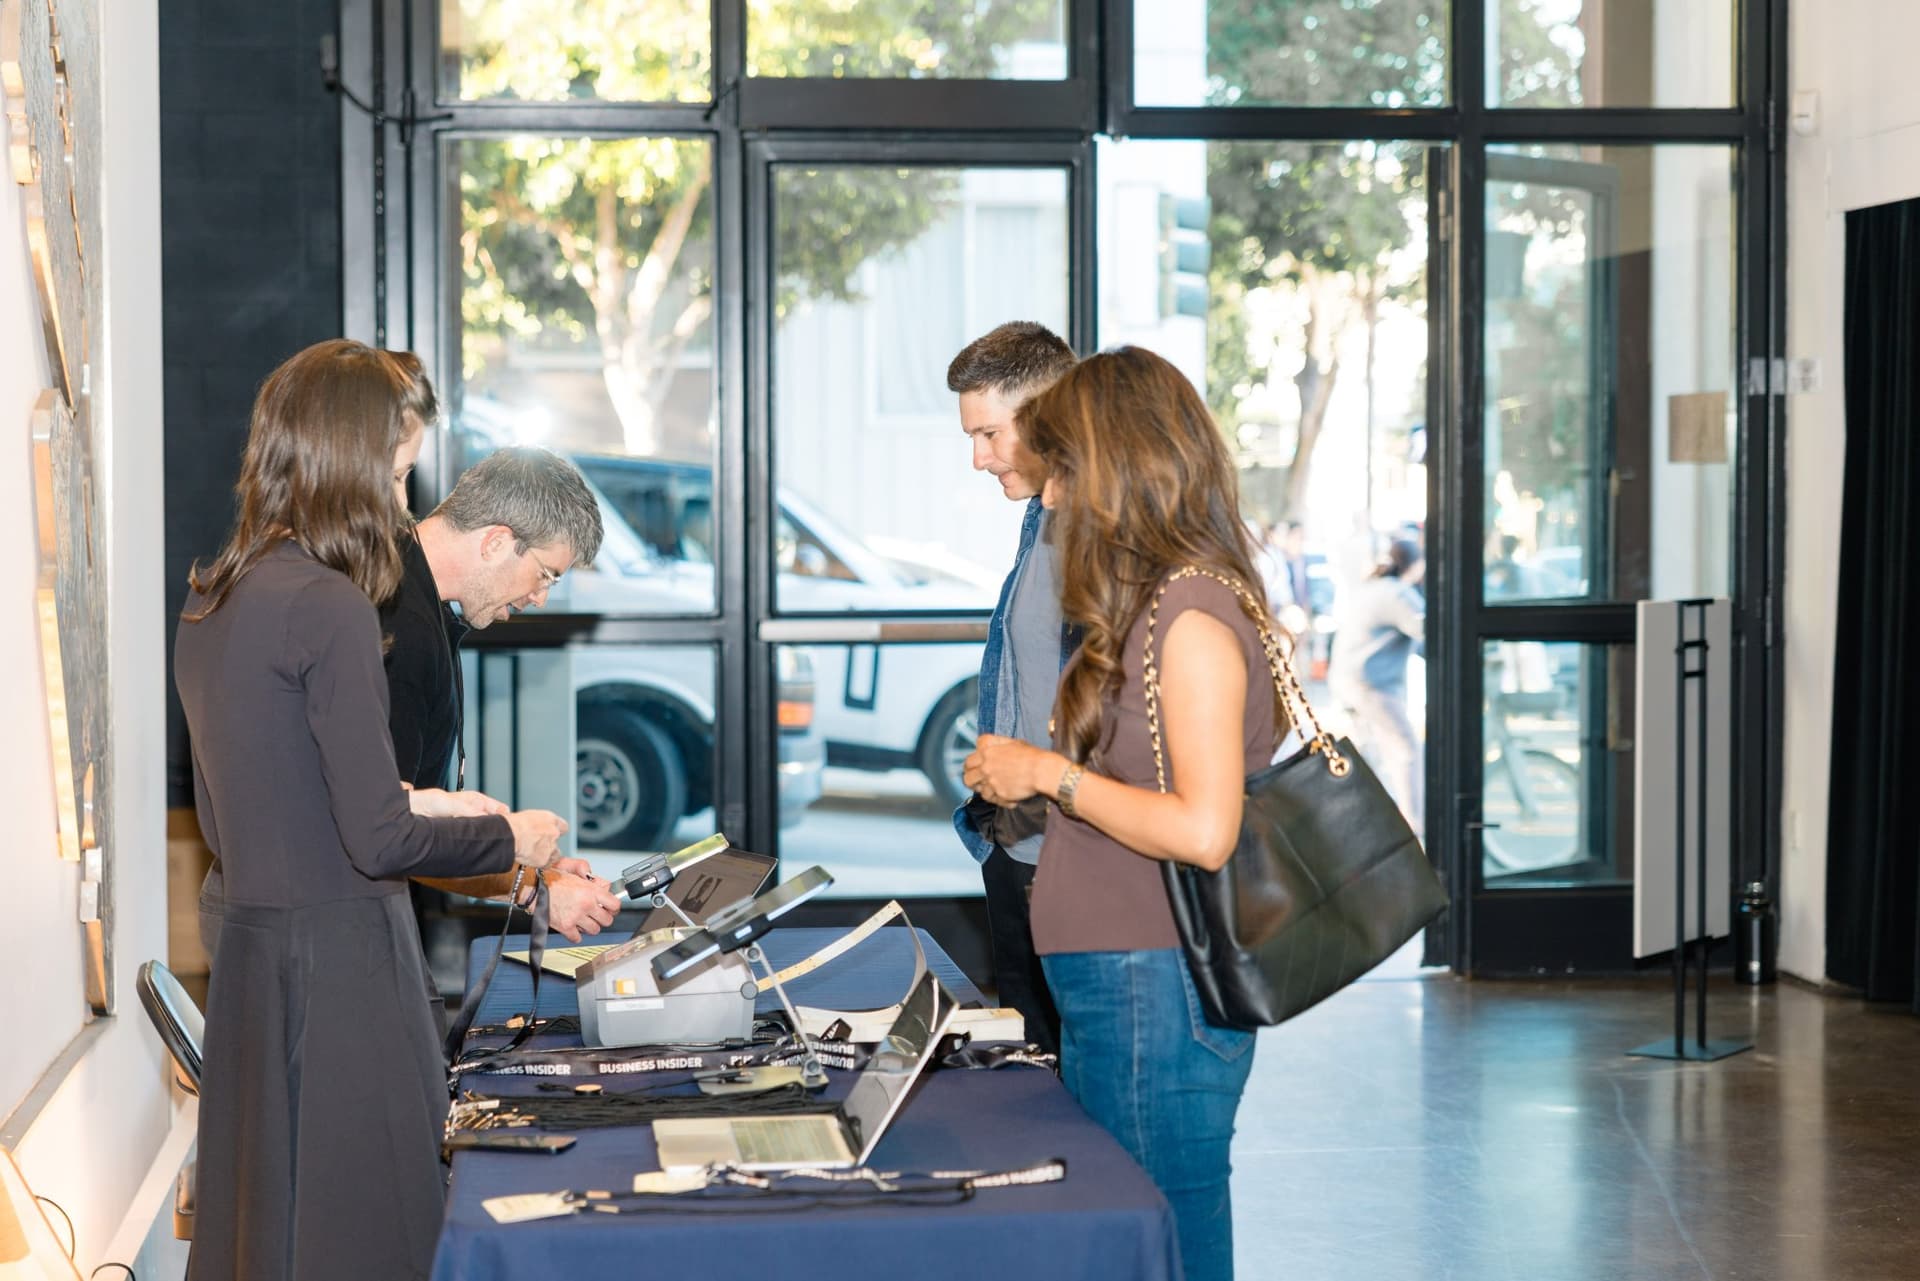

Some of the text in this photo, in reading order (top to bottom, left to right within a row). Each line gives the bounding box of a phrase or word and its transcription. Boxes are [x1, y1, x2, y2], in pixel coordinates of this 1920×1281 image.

[525, 1064, 572, 1075] INSIDER
[599, 1057, 703, 1074] BUSINESS INSIDER
